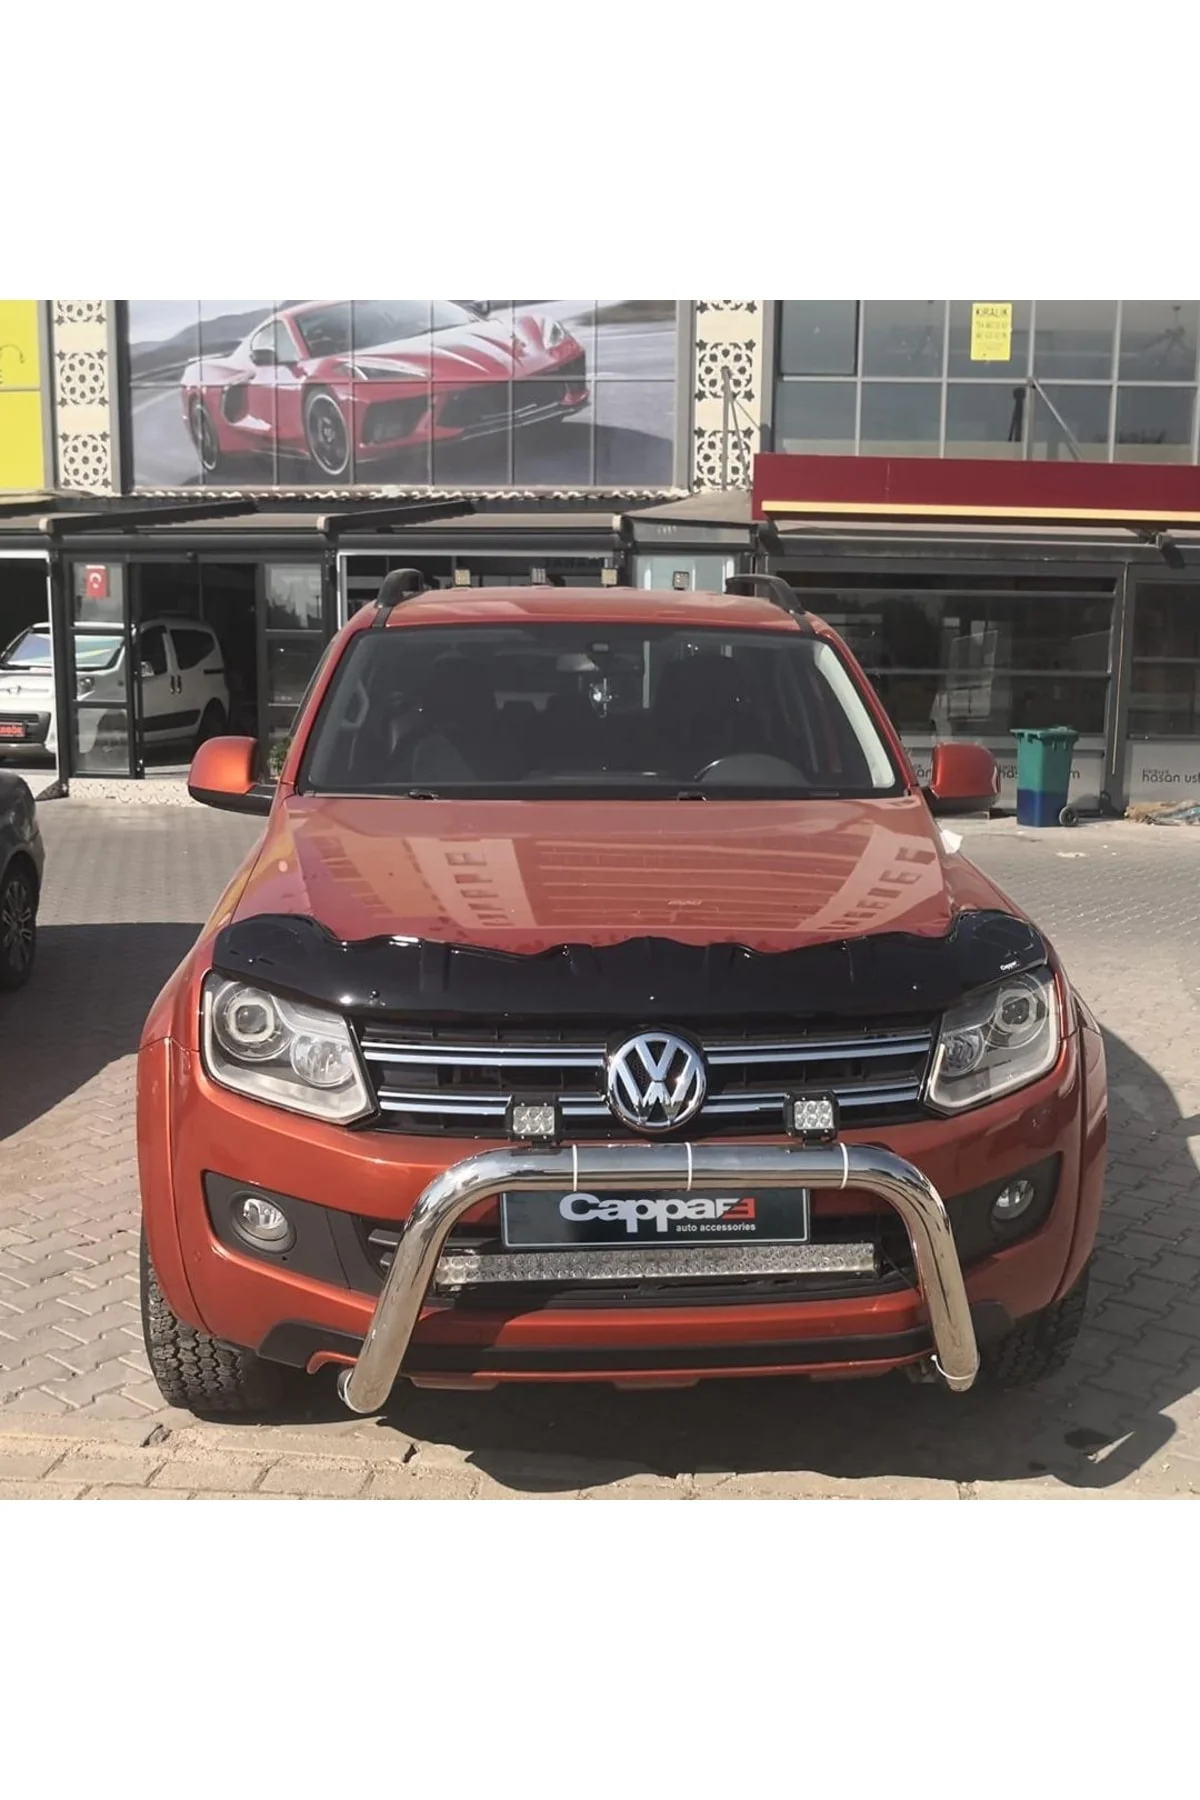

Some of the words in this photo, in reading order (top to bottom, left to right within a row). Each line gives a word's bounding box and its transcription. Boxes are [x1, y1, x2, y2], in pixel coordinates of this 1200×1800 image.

[1142, 768, 1181, 783] hasan
[675, 1223, 698, 1232] auto
[700, 1221, 756, 1232] accessories
